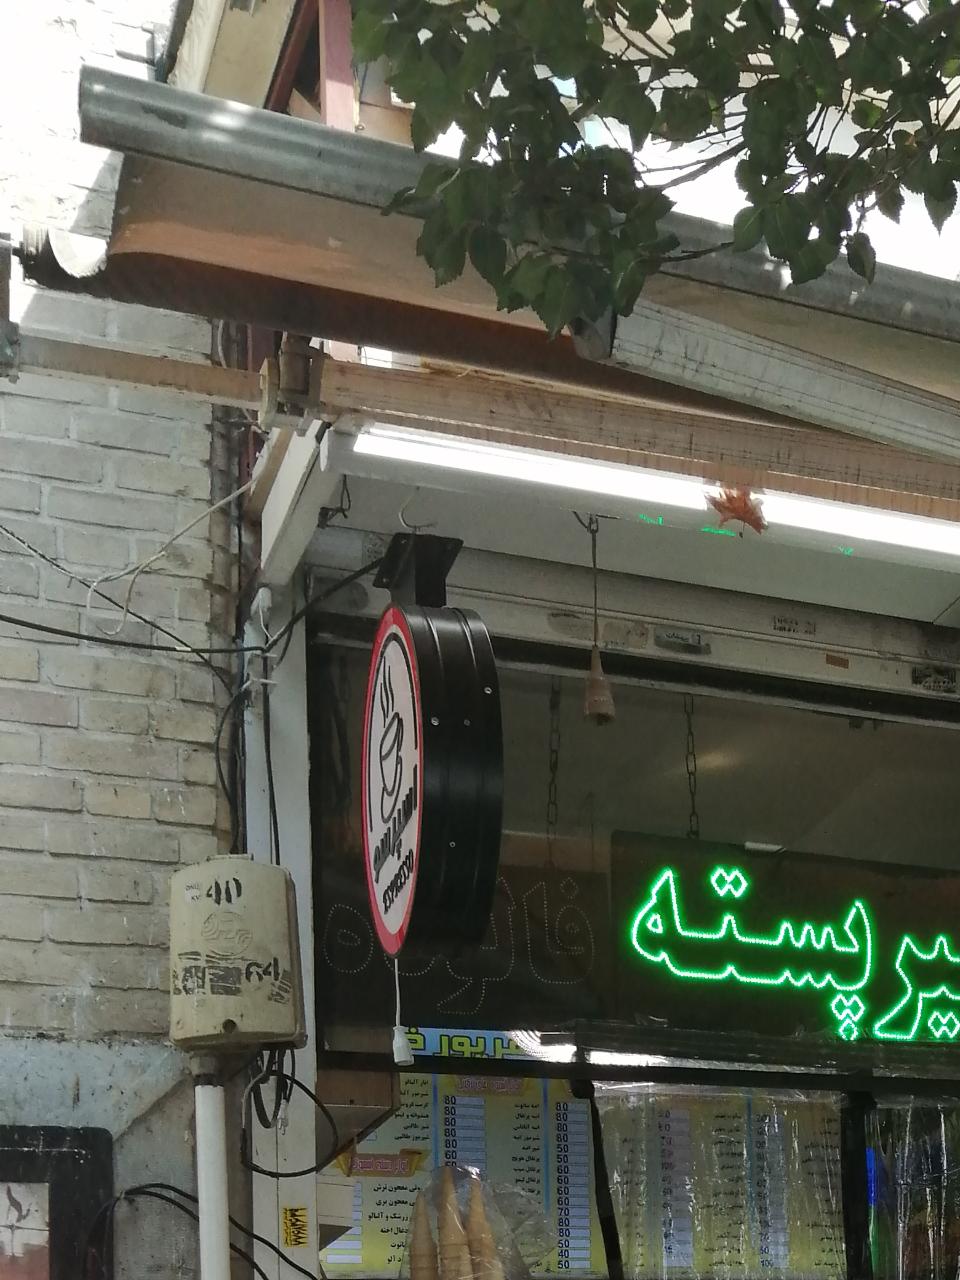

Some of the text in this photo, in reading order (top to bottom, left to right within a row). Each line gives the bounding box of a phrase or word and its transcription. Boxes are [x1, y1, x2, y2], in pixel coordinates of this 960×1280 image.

[631, 866, 876, 1042] پسته
[444, 1096, 456, 1105] 80
[444, 1106, 456, 1115] 80
[556, 1103, 568, 1111] 80
[444, 1117, 456, 1126] 80
[556, 1113, 568, 1122] 80
[556, 1123, 568, 1132] 80
[444, 1128, 456, 1137] 80
[556, 1134, 568, 1143] 80
[445, 1139, 458, 1149] 80
[557, 1144, 569, 1153] 50
[557, 1155, 569, 1163] 50
[557, 1165, 569, 1174] 60
[557, 1176, 569, 1185] 60
[557, 1186, 569, 1195] 60
[557, 1197, 569, 1206] 60
[558, 1207, 570, 1216] 70
[558, 1218, 570, 1227] 80
[558, 1228, 570, 1237] 80
[558, 1239, 570, 1248] 50
[558, 1249, 570, 1258] 40
[558, 1260, 570, 1269] 50
